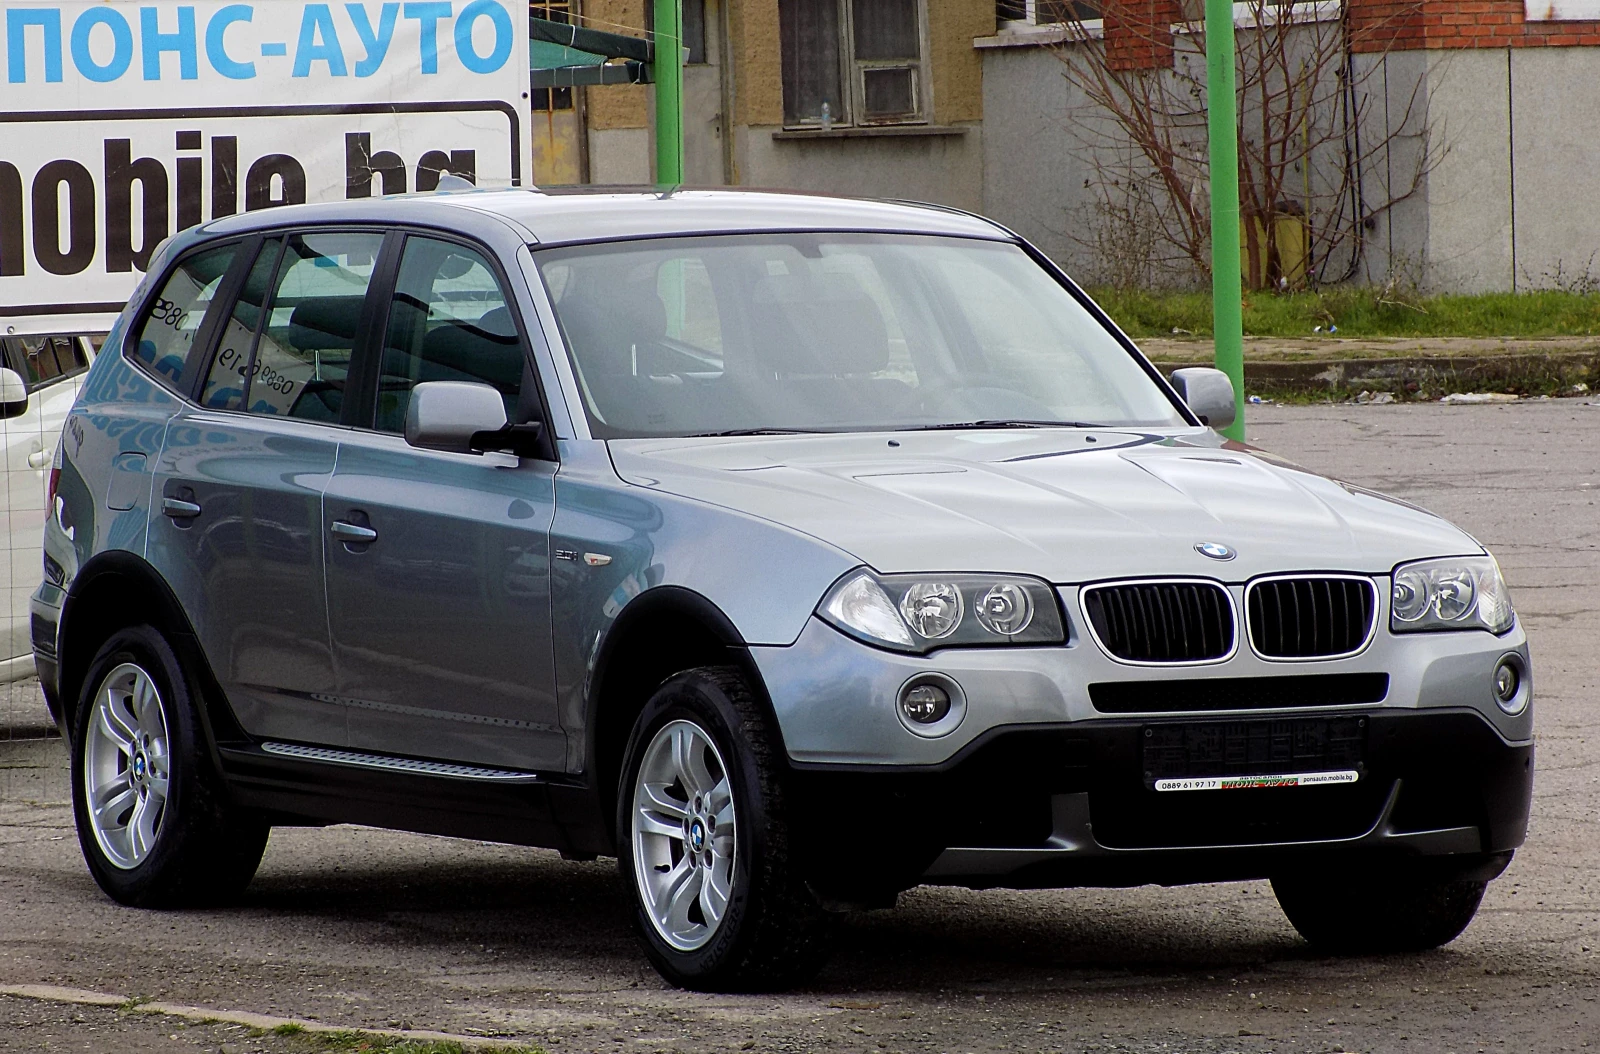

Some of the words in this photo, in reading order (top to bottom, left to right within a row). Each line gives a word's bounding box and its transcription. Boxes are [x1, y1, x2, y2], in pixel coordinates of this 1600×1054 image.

[5, 0, 514, 84] ПОНС-АУТО
[1303, 774, 1353, 783] ponsauto.mobile.bg
[1161, 782, 1181, 790] 0889
[1183, 781, 1192, 789] 61
[1207, 780, 1216, 788] 17
